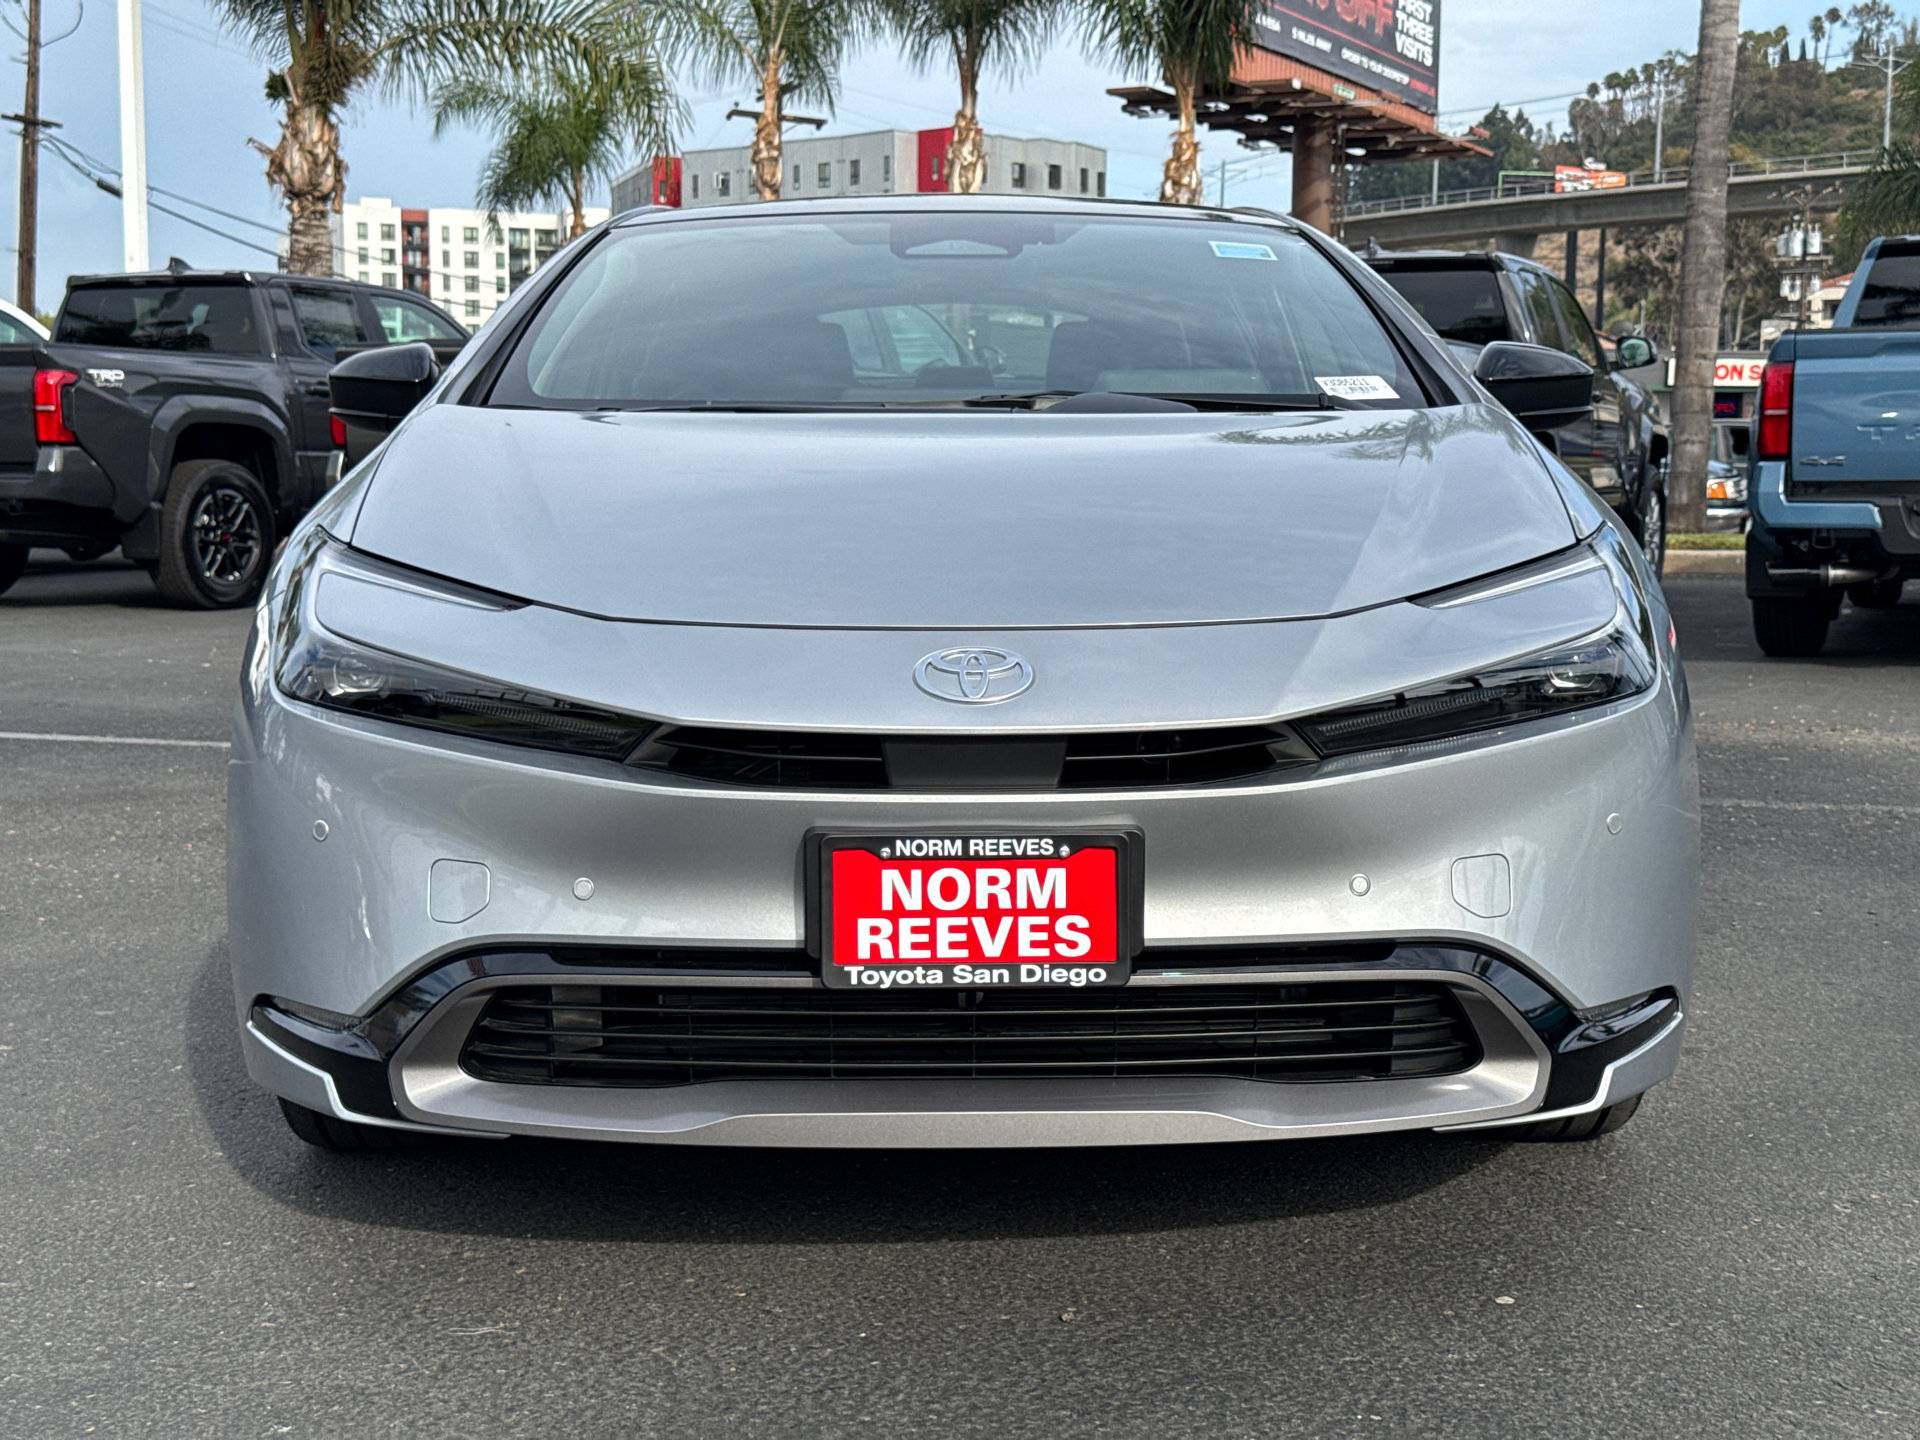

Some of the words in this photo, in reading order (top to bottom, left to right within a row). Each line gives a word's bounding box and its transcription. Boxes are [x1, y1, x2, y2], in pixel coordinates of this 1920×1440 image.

[1395, 10, 1434, 46] THREE
[1395, 31, 1433, 67] VISITS
[86, 369, 125, 382] TRD
[896, 840, 962, 856] NORM
[970, 839, 1054, 855] REEVES
[882, 868, 1066, 910] NORM
[858, 915, 1091, 959] REEVES
[844, 966, 943, 988] Toyota
[953, 965, 1009, 983] San
[1021, 964, 1106, 986] Diego
